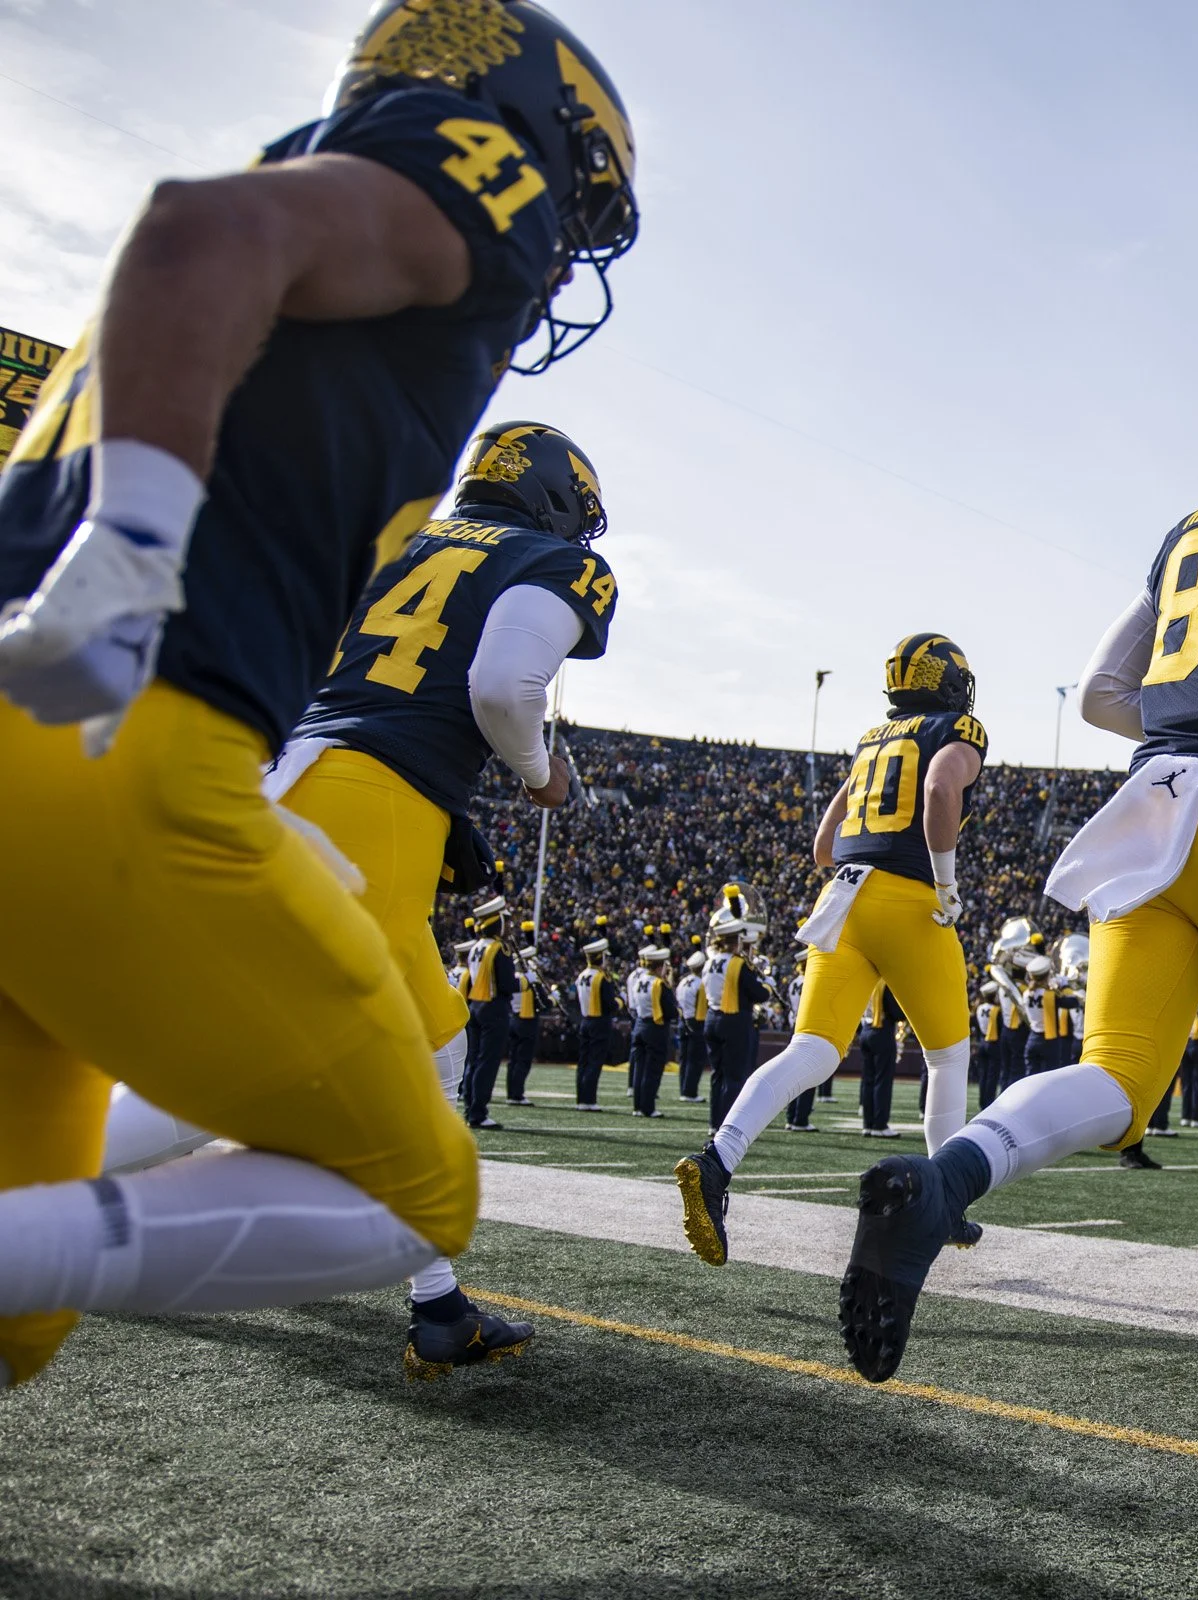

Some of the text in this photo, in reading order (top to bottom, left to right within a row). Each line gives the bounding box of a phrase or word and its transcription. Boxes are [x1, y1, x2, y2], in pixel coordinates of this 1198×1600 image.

[435, 118, 546, 233] 41
[418, 519, 511, 545] NEGAL
[569, 557, 616, 617] 14
[327, 547, 488, 695] 4
[859, 715, 926, 745] BEETHAM
[954, 714, 985, 748] 40
[840, 738, 920, 838] 40
[836, 866, 865, 886] M
[471, 946, 487, 963] M
[709, 958, 726, 974] M
[580, 974, 593, 988] M
[636, 980, 651, 993] M
